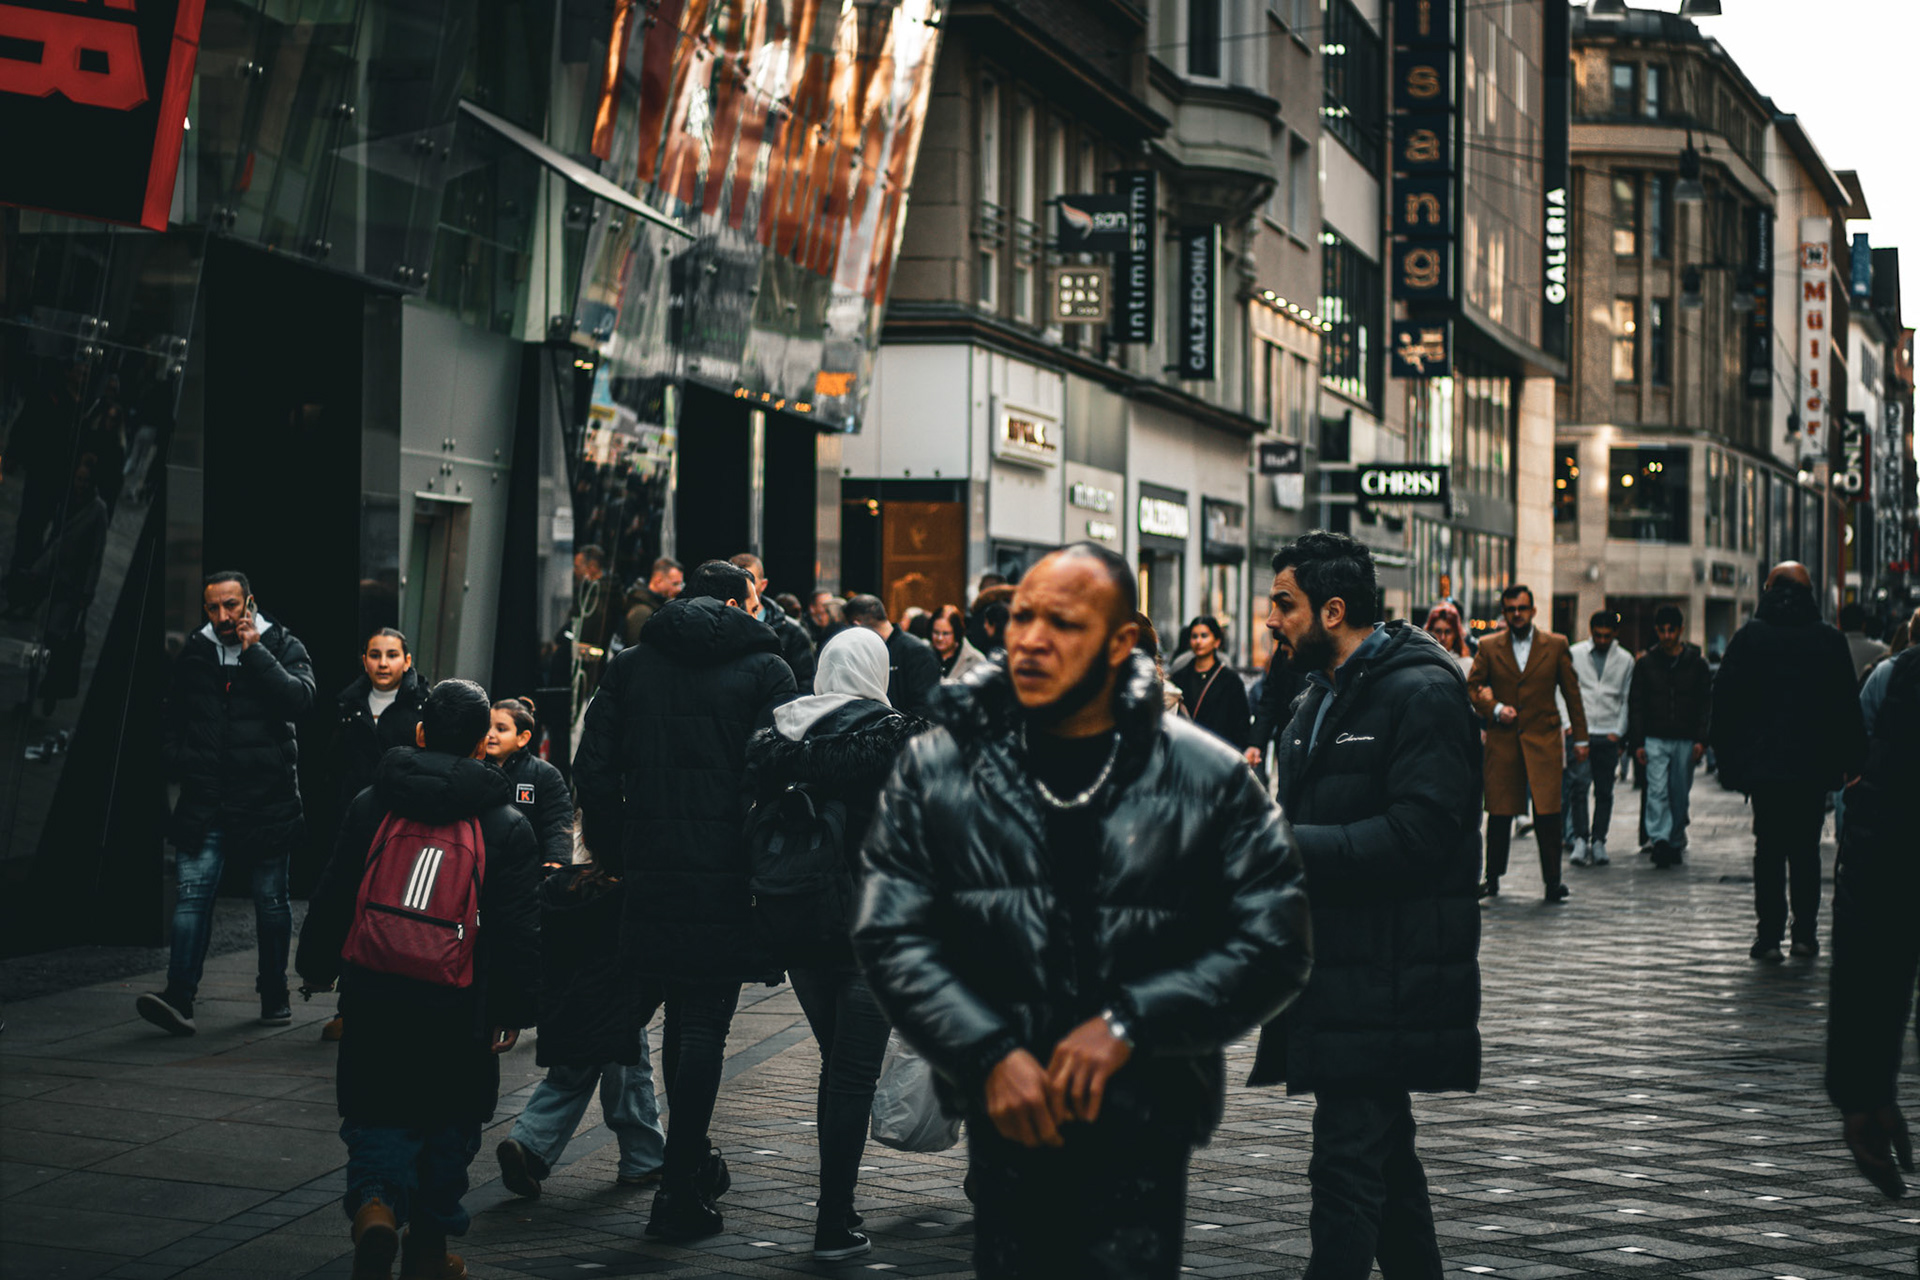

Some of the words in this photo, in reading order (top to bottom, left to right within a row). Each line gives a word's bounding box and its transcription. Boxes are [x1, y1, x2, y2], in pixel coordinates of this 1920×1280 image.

[1546, 188, 1567, 304] GALERIA
[1190, 236, 1207, 370] CALZEDONIA
[1360, 469, 1443, 496] CHRIST
[1844, 417, 1862, 493] ONLY
[521, 790, 530, 801] K
